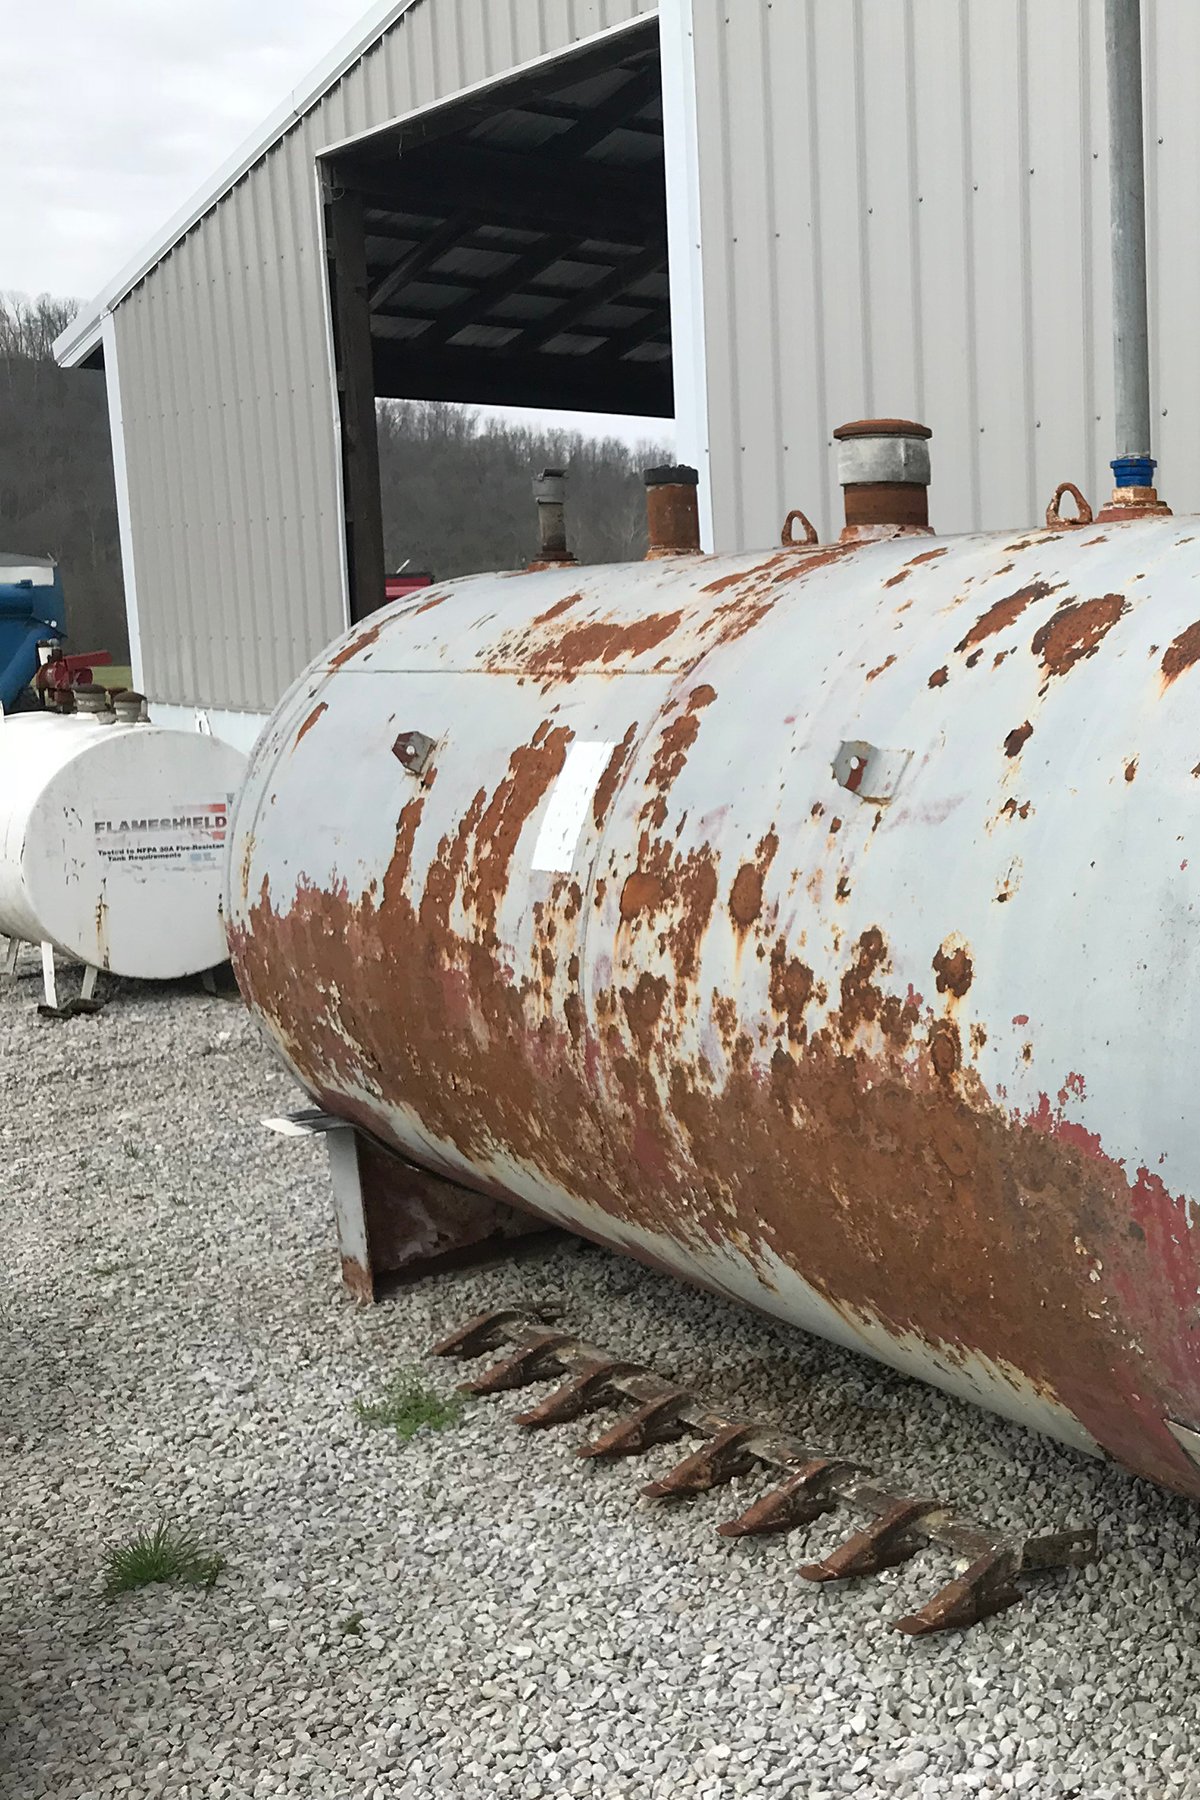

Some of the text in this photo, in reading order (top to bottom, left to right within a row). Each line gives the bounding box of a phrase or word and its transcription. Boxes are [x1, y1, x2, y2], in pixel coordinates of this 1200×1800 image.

[94, 816, 227, 834] FLAMESHIELD
[98, 849, 125, 857] Tested
[136, 846, 157, 854] NFPA
[128, 853, 182, 861] Requirements
